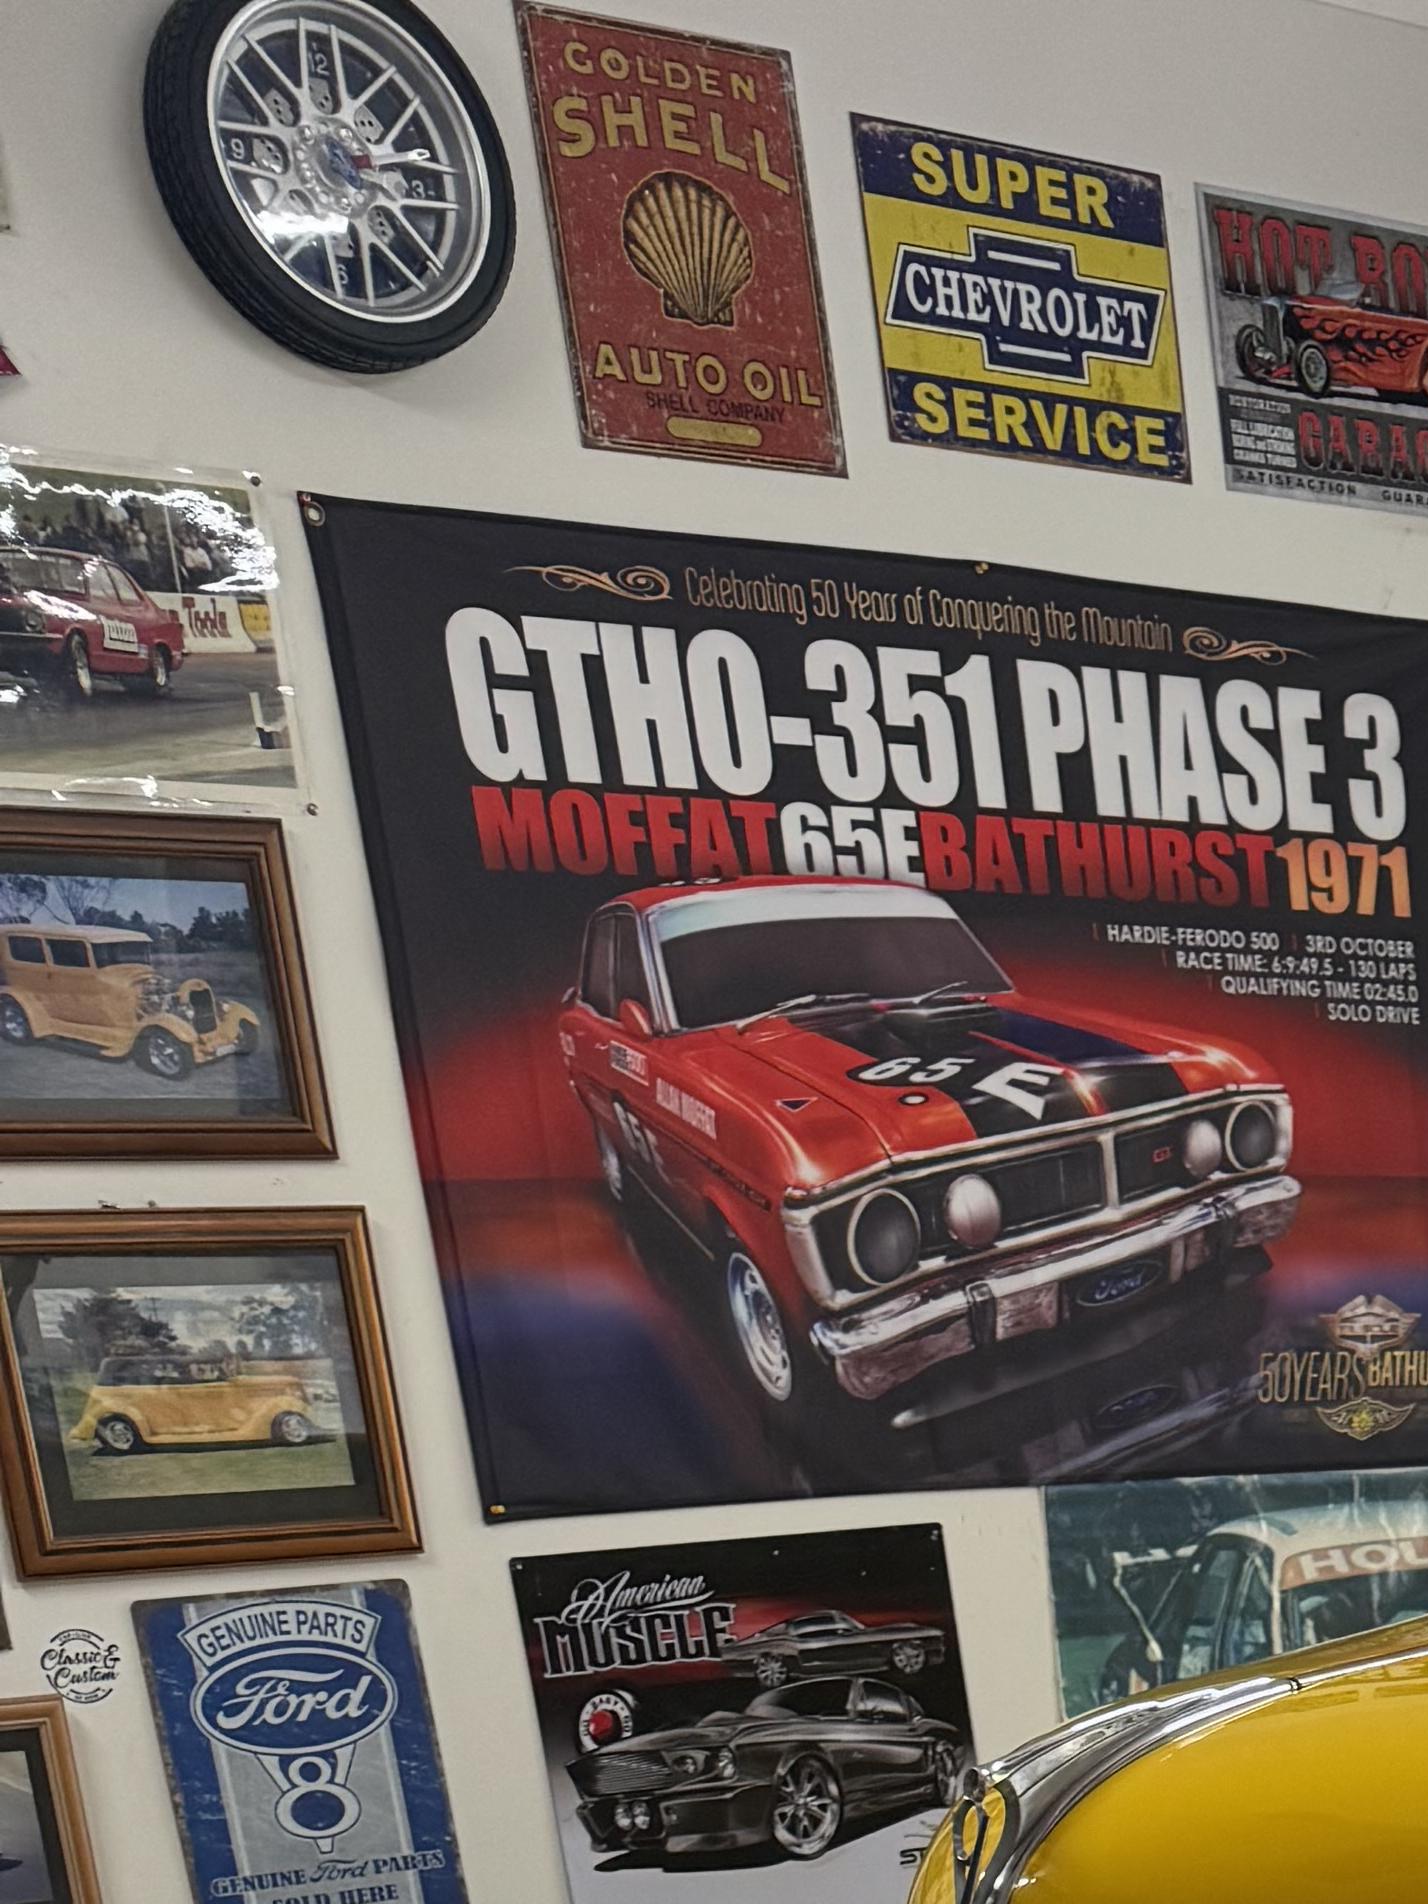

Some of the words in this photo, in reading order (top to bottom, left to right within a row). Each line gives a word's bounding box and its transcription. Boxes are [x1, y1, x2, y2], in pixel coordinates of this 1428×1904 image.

[564, 39, 757, 103] GOLDEN
[552, 94, 792, 196] SHELL
[910, 141, 1115, 229] SUPER
[1215, 208, 1333, 297] HOT
[904, 261, 1148, 349] CHEVROLET
[594, 341, 728, 397] AUTO
[742, 361, 824, 409] OIL
[646, 390, 699, 414] SHELL
[706, 397, 788, 426] COMPANY
[912, 381, 1170, 467] SERVICE
[1231, 468, 1357, 496] SATISFACTION
[685, 567, 807, 625] Celebrating
[810, 579, 840, 618] 50
[844, 582, 898, 622] Years
[904, 586, 924, 625] of
[929, 589, 1040, 647] Conquering
[1044, 602, 1076, 640] the
[1081, 607, 1172, 652] Mountain
[445, 606, 1007, 808] GTHO-351
[1016, 659, 1334, 834] PHASE
[1343, 692, 1407, 841] 3
[471, 786, 777, 878] MOFFAT
[919, 810, 1275, 907] BATHURST
[1275, 838, 1412, 918] 1971
[1107, 924, 1245, 949] HARDIE-FERODO
[1250, 931, 1279, 951] 500
[1305, 934, 1337, 953] 3RD
[1340, 937, 1415, 959] OCTOBER
[1176, 951, 1223, 971] RACE
[1349, 960, 1377, 979] 130
[1379, 962, 1417, 981] LAPS
[1221, 975, 1321, 998] QUALIFYING
[1324, 980, 1361, 1000] TIME
[1327, 1002, 1371, 1022] SOLO
[1375, 1005, 1420, 1025] DRIVE
[857, 1057, 976, 1084] 65
[561, 1571, 716, 1630] American
[41, 1648, 102, 1671] Classic
[103, 1644, 121, 1669] &
[196, 1611, 291, 1658] GENUINE
[296, 1609, 366, 1645] PARTS
[534, 1603, 737, 1678] MUSCLE
[54, 1666, 120, 1689] Custom
[216, 1669, 372, 1730] Ford
[211, 1868, 307, 1898] GENUINE
[310, 1859, 371, 1883] Ford
[373, 1850, 446, 1875] PARTS
